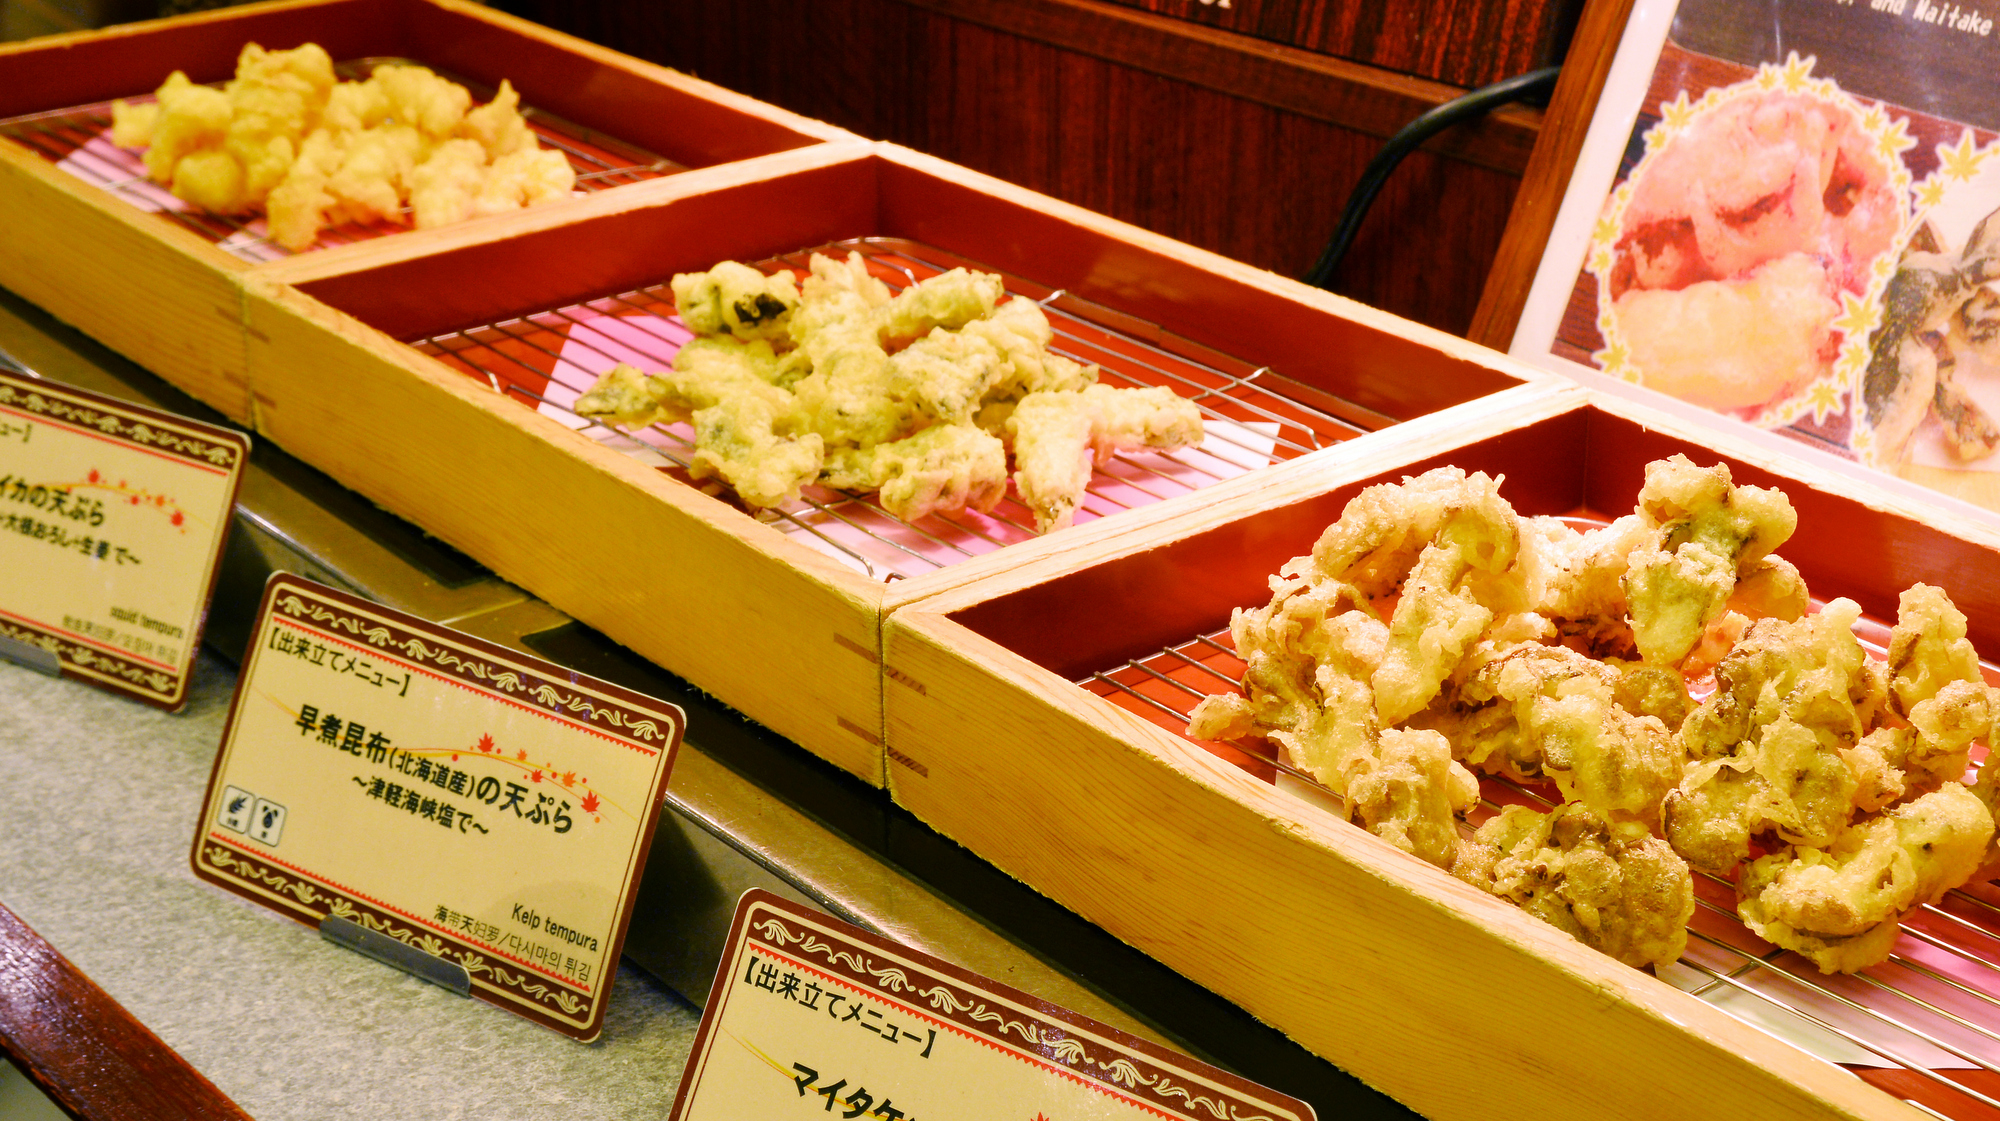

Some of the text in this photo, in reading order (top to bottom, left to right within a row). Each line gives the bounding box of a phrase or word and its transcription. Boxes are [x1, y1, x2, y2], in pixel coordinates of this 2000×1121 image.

[1912, 0, 1993, 36] Maitake
[269, 627, 411, 697] 【出来立てメニュー】
[295, 704, 573, 834] 早煮昆布(北海道産)の天ぷら
[511, 903, 599, 952] Kelp tempura
[744, 956, 937, 1059] 【出来立てメニュー】
[792, 1061, 916, 1121] マイタケ
